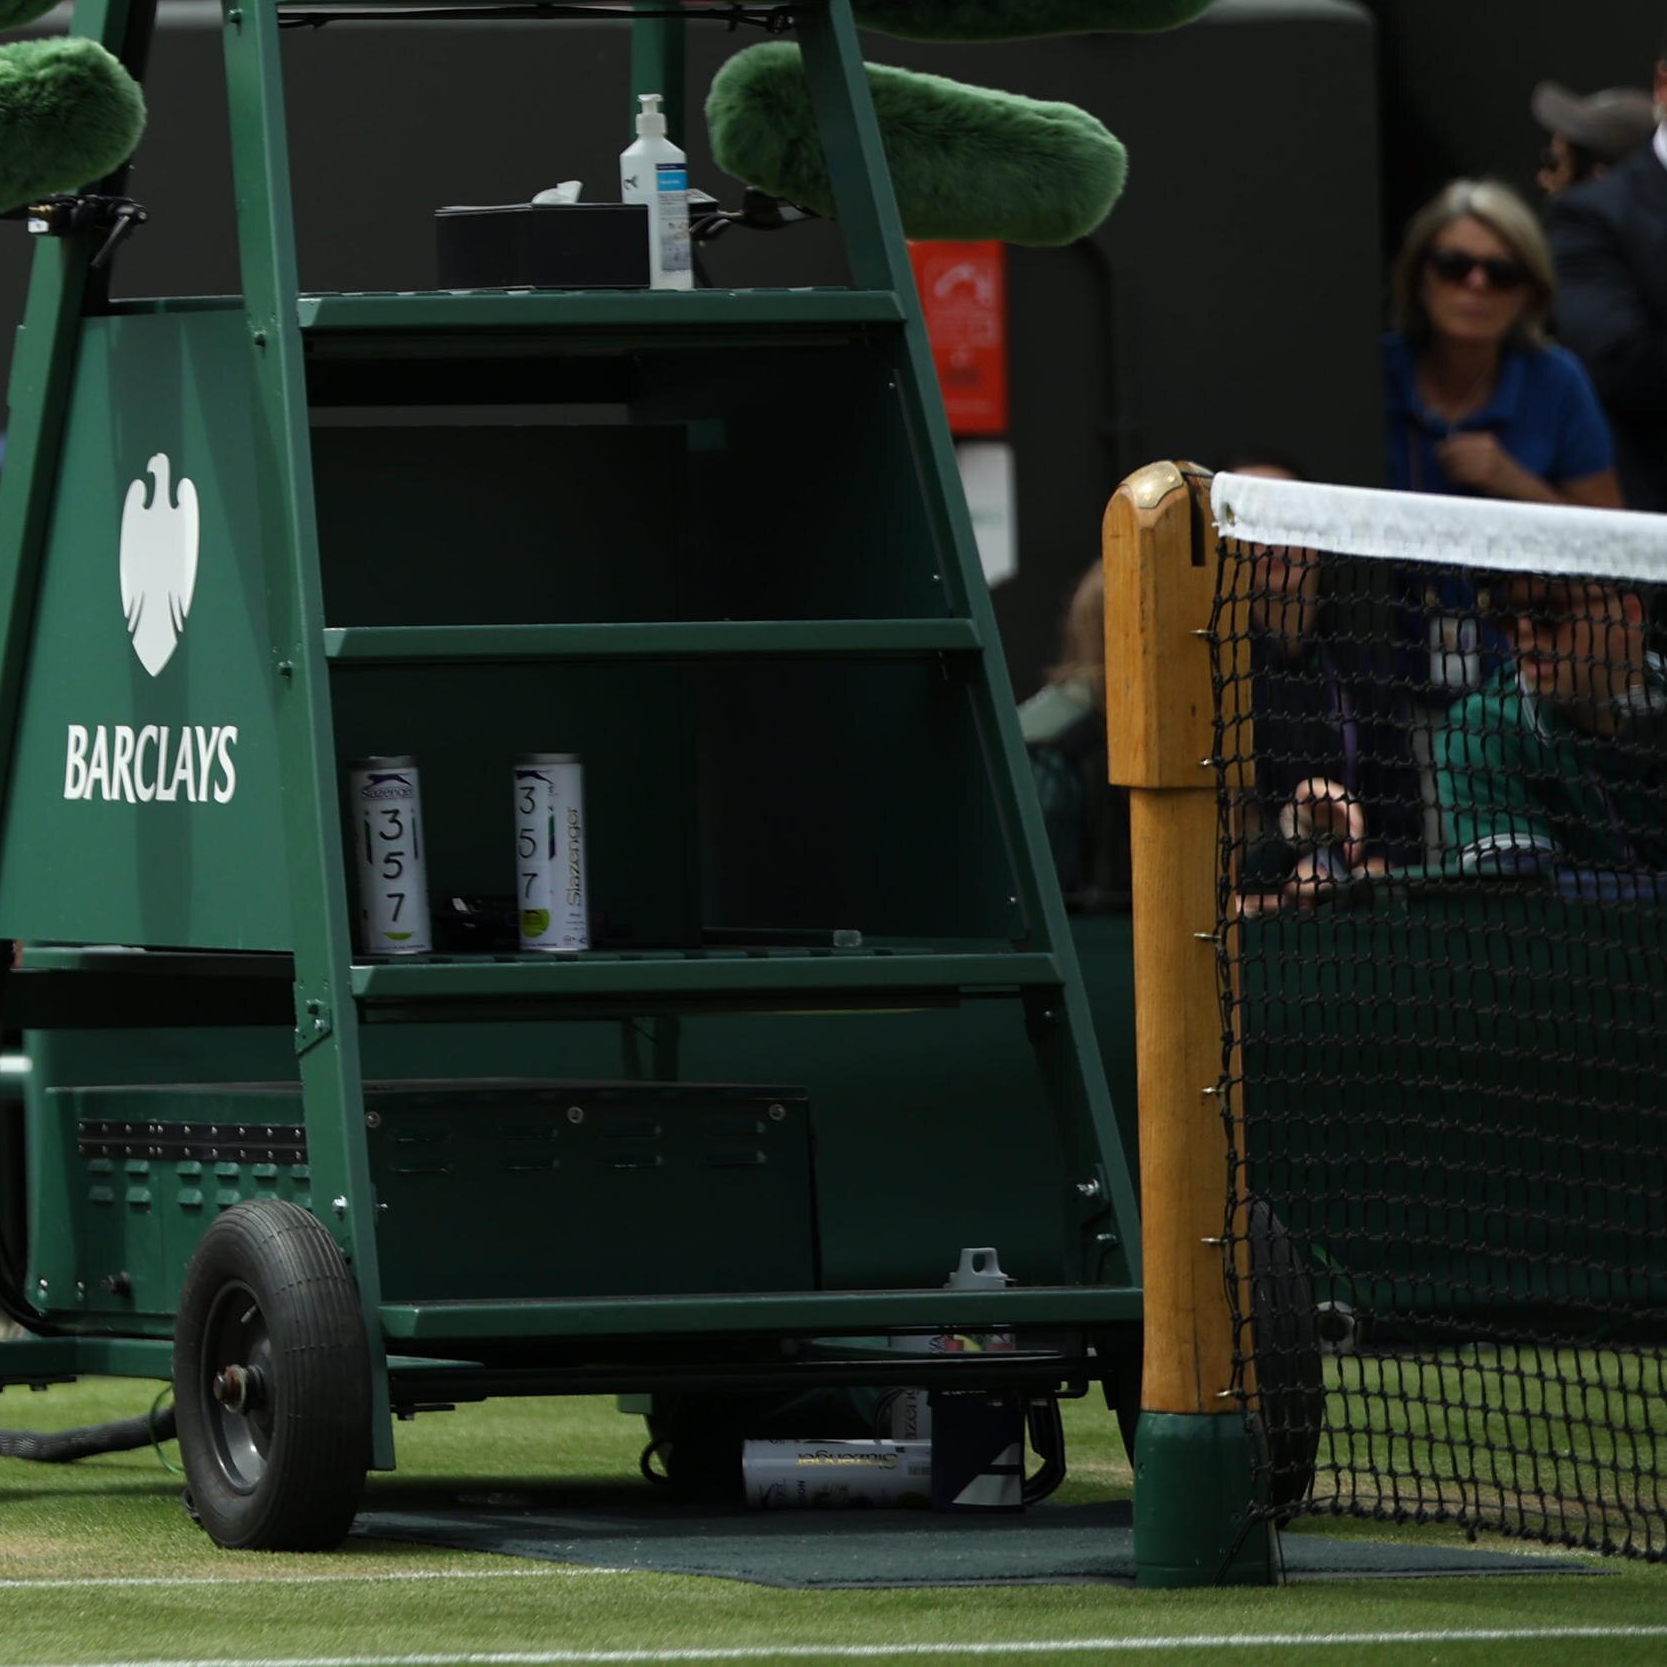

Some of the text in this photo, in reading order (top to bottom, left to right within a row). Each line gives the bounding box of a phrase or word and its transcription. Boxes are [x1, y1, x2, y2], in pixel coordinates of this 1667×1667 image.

[63, 724, 238, 805] BARCLAYS
[519, 787, 535, 815] 3
[379, 809, 403, 840] 3
[518, 828, 537, 859] 5
[383, 851, 405, 880] 5
[521, 873, 538, 899] 7
[386, 892, 405, 922] 7
[795, 1448, 899, 1471] Slazenger
